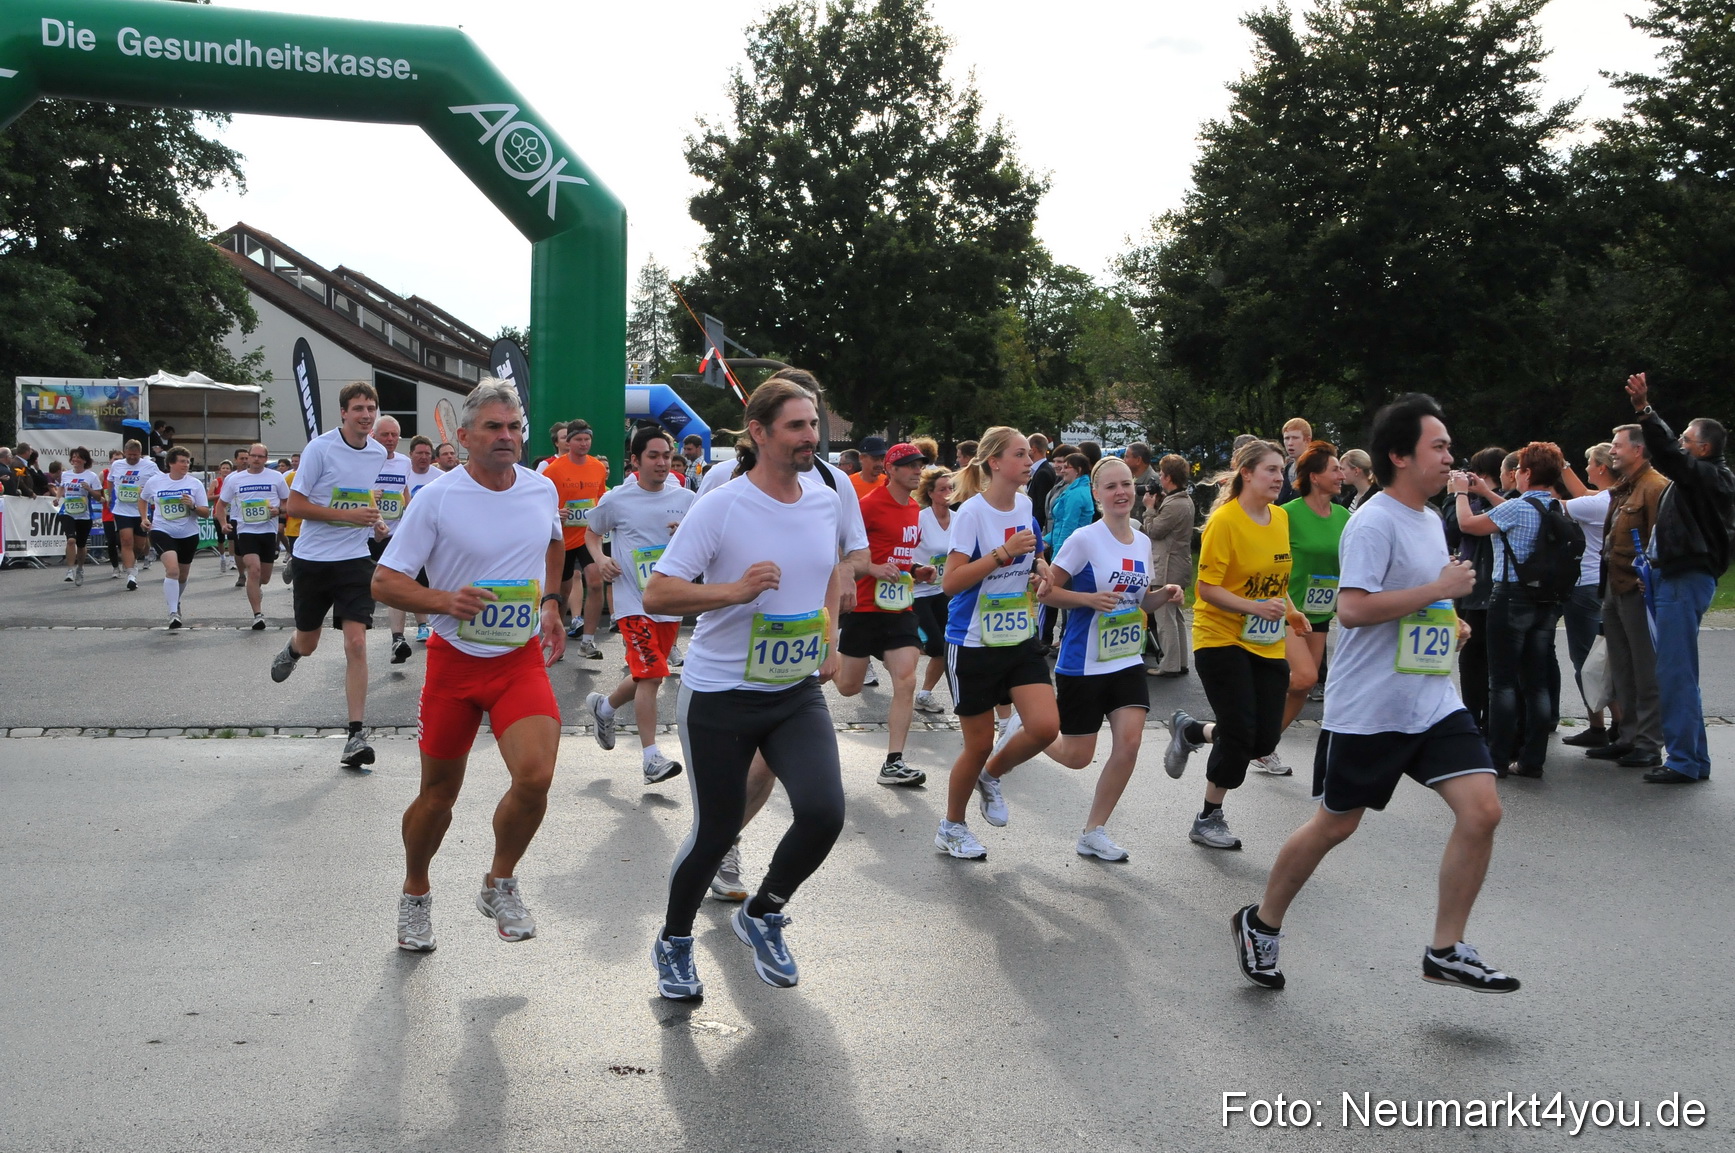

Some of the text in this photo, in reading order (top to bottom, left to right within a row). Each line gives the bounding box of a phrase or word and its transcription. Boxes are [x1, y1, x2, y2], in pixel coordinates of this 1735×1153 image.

[41, 18, 418, 80] Die Gesundheitskasse.
[448, 102, 590, 221] AOK
[27, 396, 71, 410] TLA
[119, 490, 138, 498] 1252
[163, 504, 185, 514] 886
[245, 506, 265, 517] 885
[1108, 571, 1149, 588] PERRAS
[879, 583, 904, 601] 261
[1307, 588, 1334, 604] 829
[983, 611, 1028, 632] 1255
[1247, 615, 1280, 634] 200
[1102, 624, 1140, 648] 1256
[1409, 626, 1450, 656] 129
[755, 635, 819, 665] 1034
